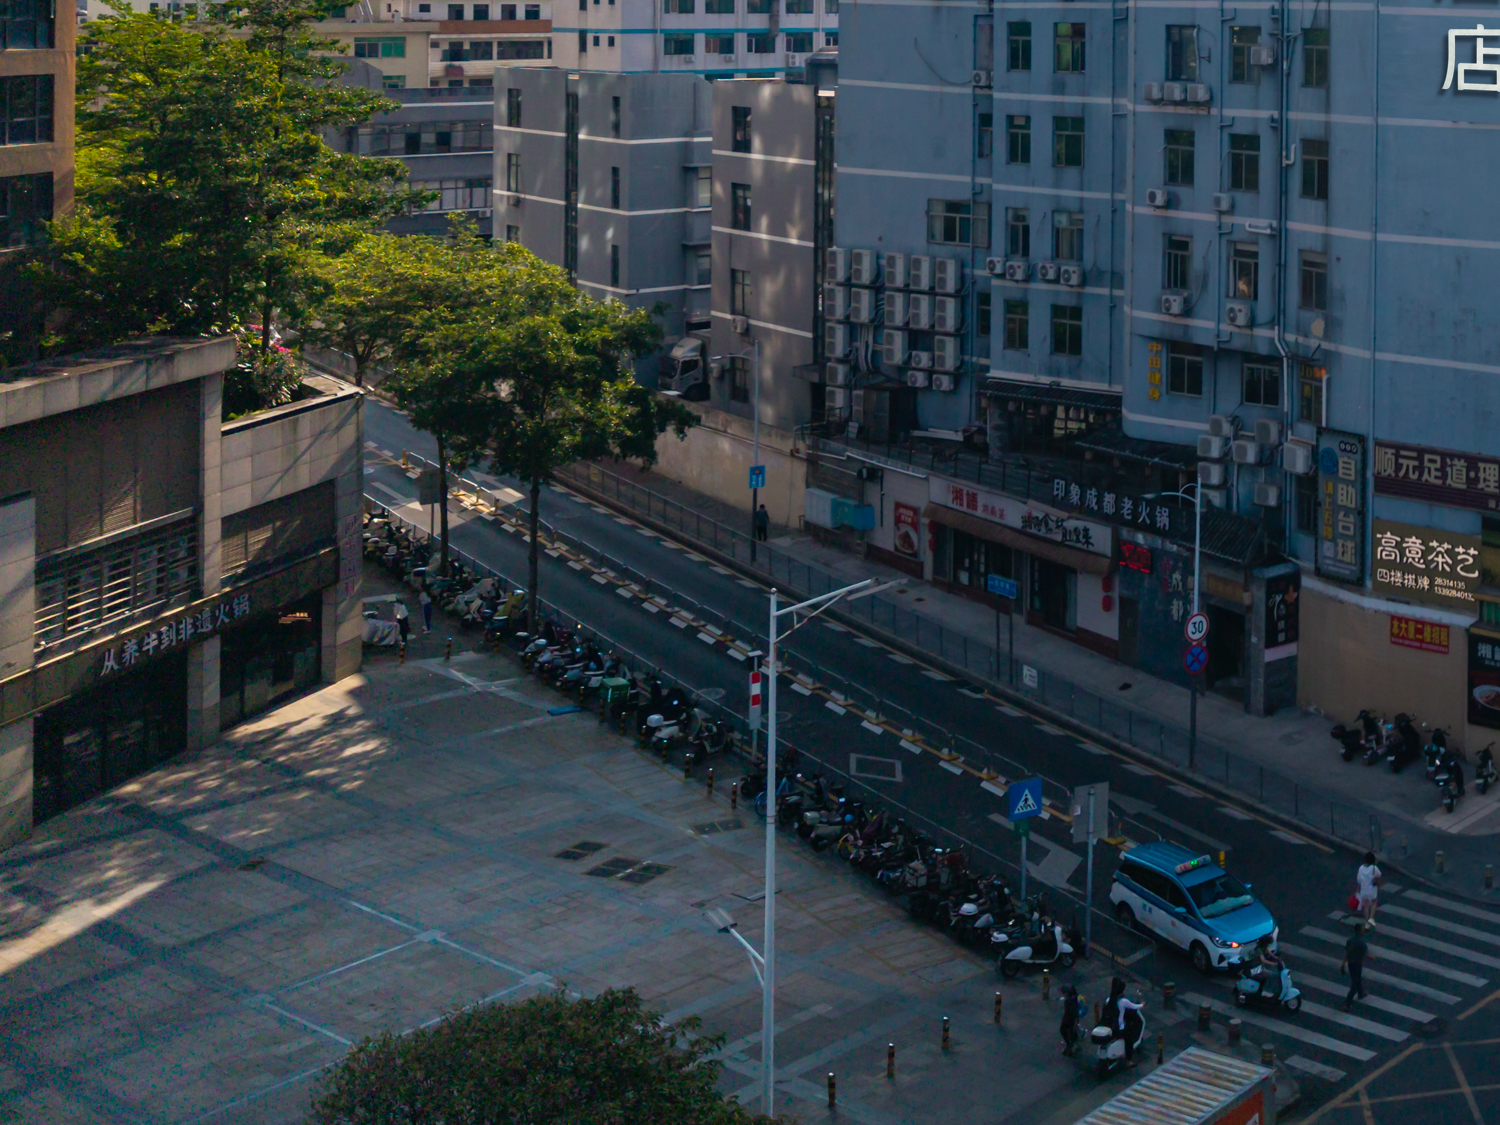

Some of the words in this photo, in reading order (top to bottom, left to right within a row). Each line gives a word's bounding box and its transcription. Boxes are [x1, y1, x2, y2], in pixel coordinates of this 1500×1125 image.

[1052, 477, 1171, 531] 印象成都老火锅
[1337, 456, 1356, 565] 自助台球
[1375, 530, 1480, 579] 高意茶艺
[1376, 567, 1431, 592] 四楼棋牌
[1191, 619, 1204, 635] 30
[1391, 617, 1449, 646] 本大厦二楼招租
